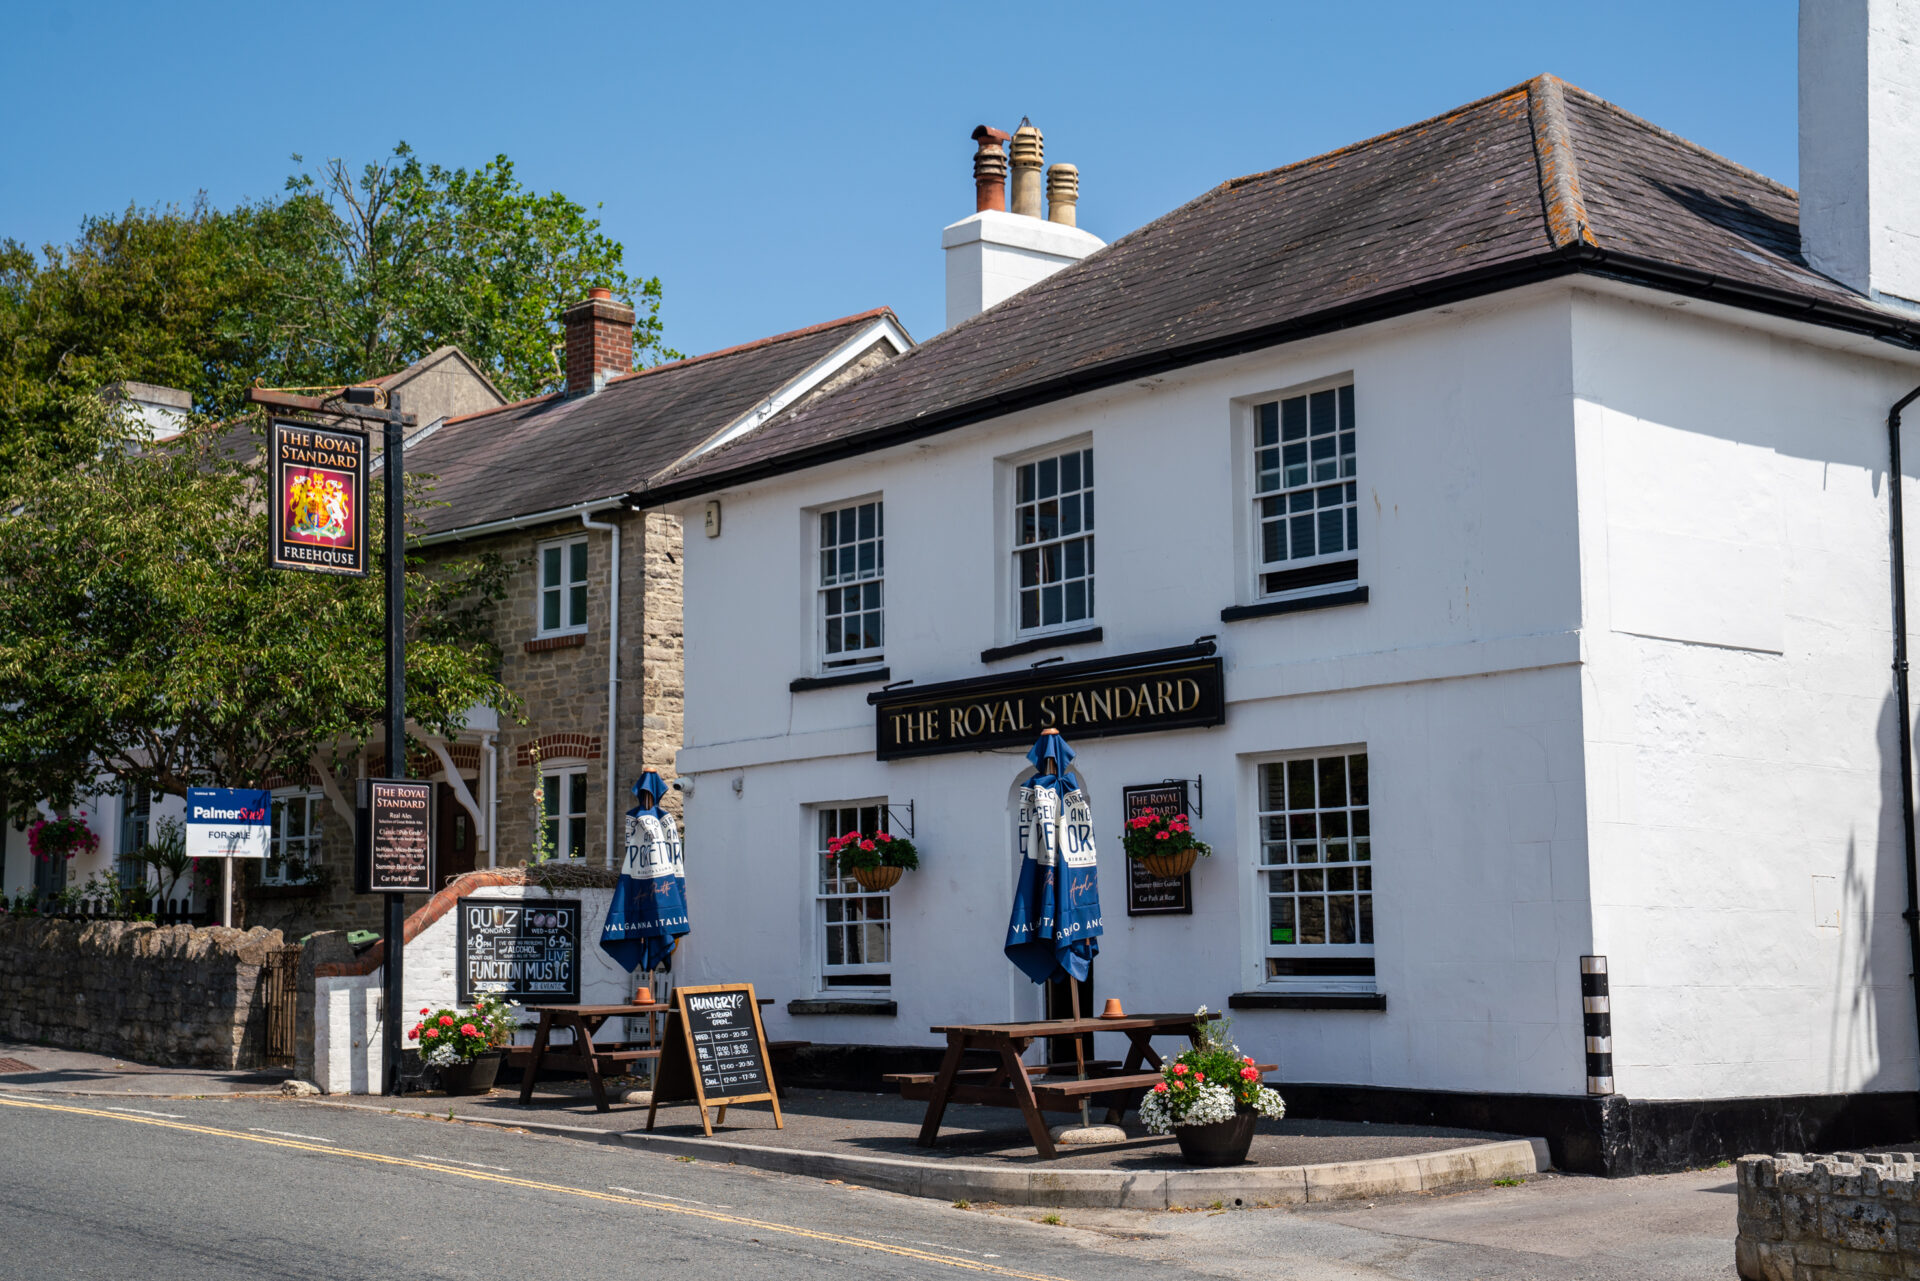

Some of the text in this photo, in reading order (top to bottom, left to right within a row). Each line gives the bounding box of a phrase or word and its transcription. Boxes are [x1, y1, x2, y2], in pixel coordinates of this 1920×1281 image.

[280, 430, 358, 454] THE ROYAL
[282, 445, 357, 468] STANDARD
[284, 546, 354, 565] FREEHOUSE
[890, 678, 1200, 744] THE ROYAL STANDARD
[376, 787, 426, 798] THE ROYAL
[1130, 793, 1178, 806] THE ROYAL
[377, 798, 425, 809] STANDARD
[604, 916, 689, 932] VALGANNA ITALIA
[548, 951, 570, 960] LIVE
[470, 962, 520, 979] FUNCTION
[525, 961, 569, 980] MUSIC
[690, 994, 743, 1011] HUNGRY?
